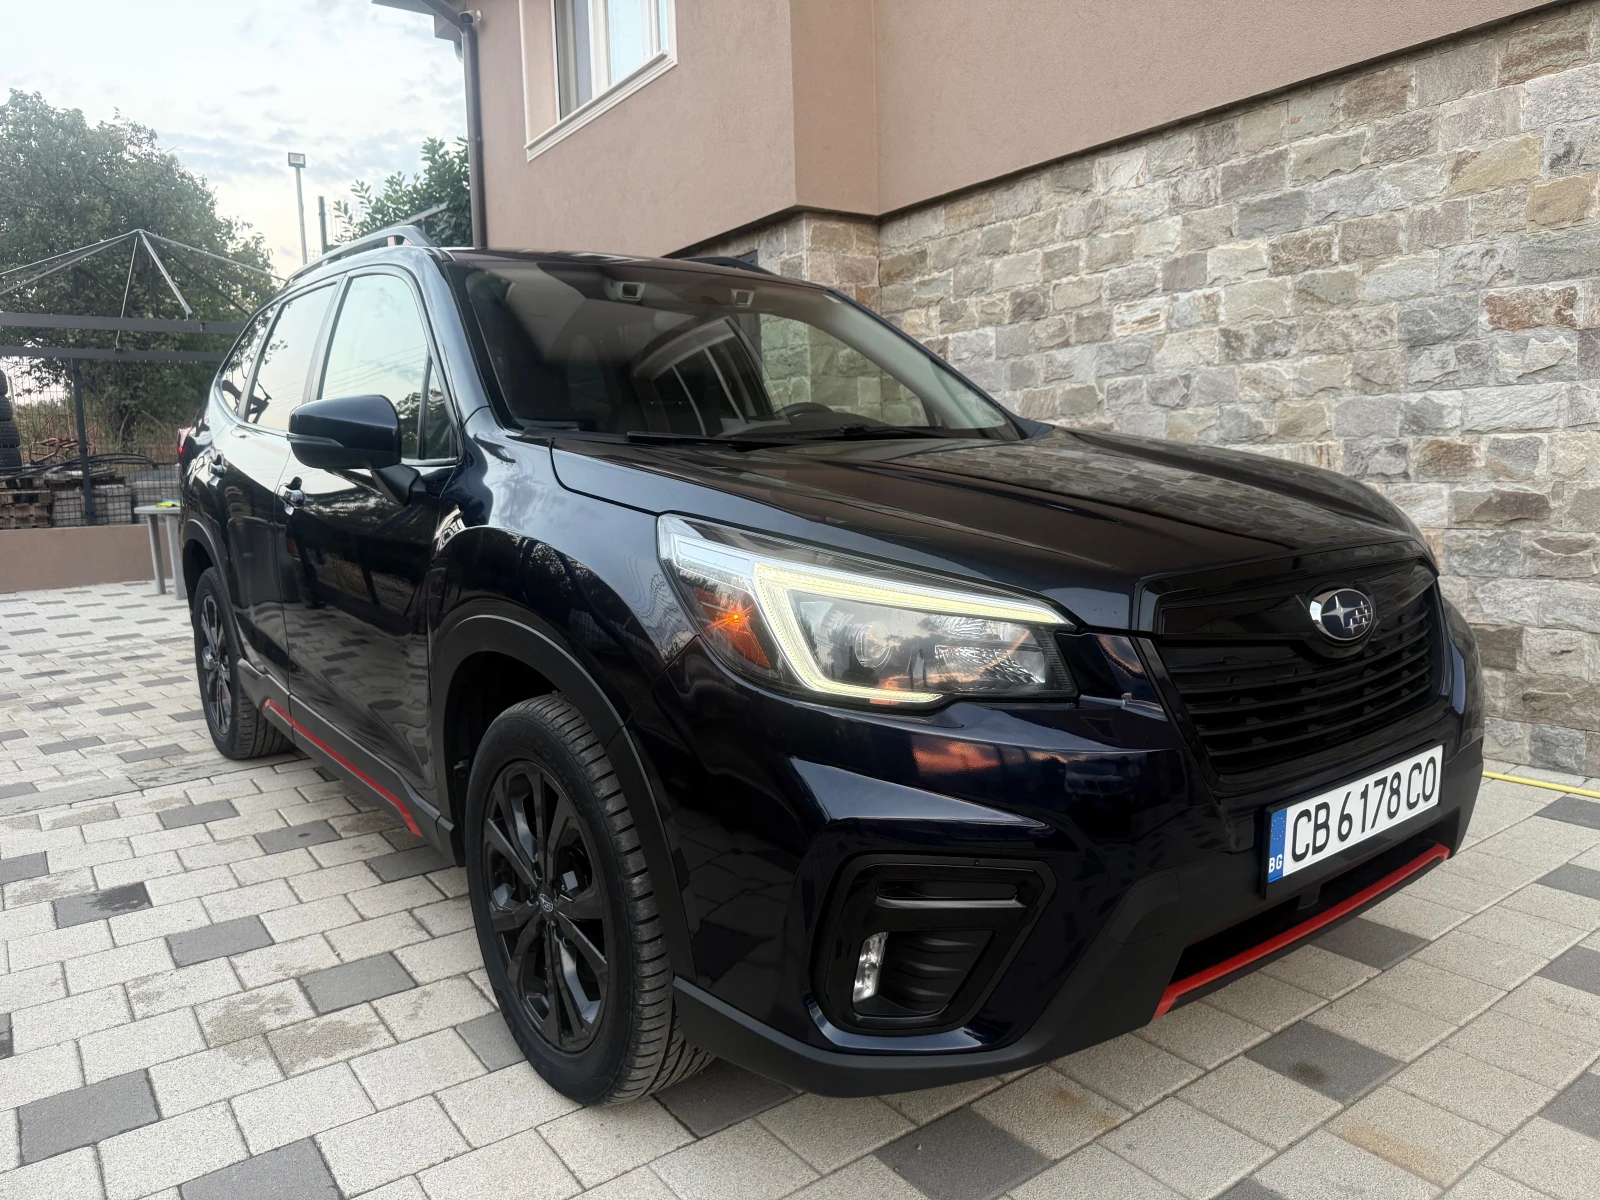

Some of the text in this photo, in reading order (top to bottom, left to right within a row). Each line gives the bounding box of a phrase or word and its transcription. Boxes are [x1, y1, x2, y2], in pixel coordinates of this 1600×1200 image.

[1291, 756, 1437, 863] CB 6178 CO
[1268, 854, 1283, 873] BG
